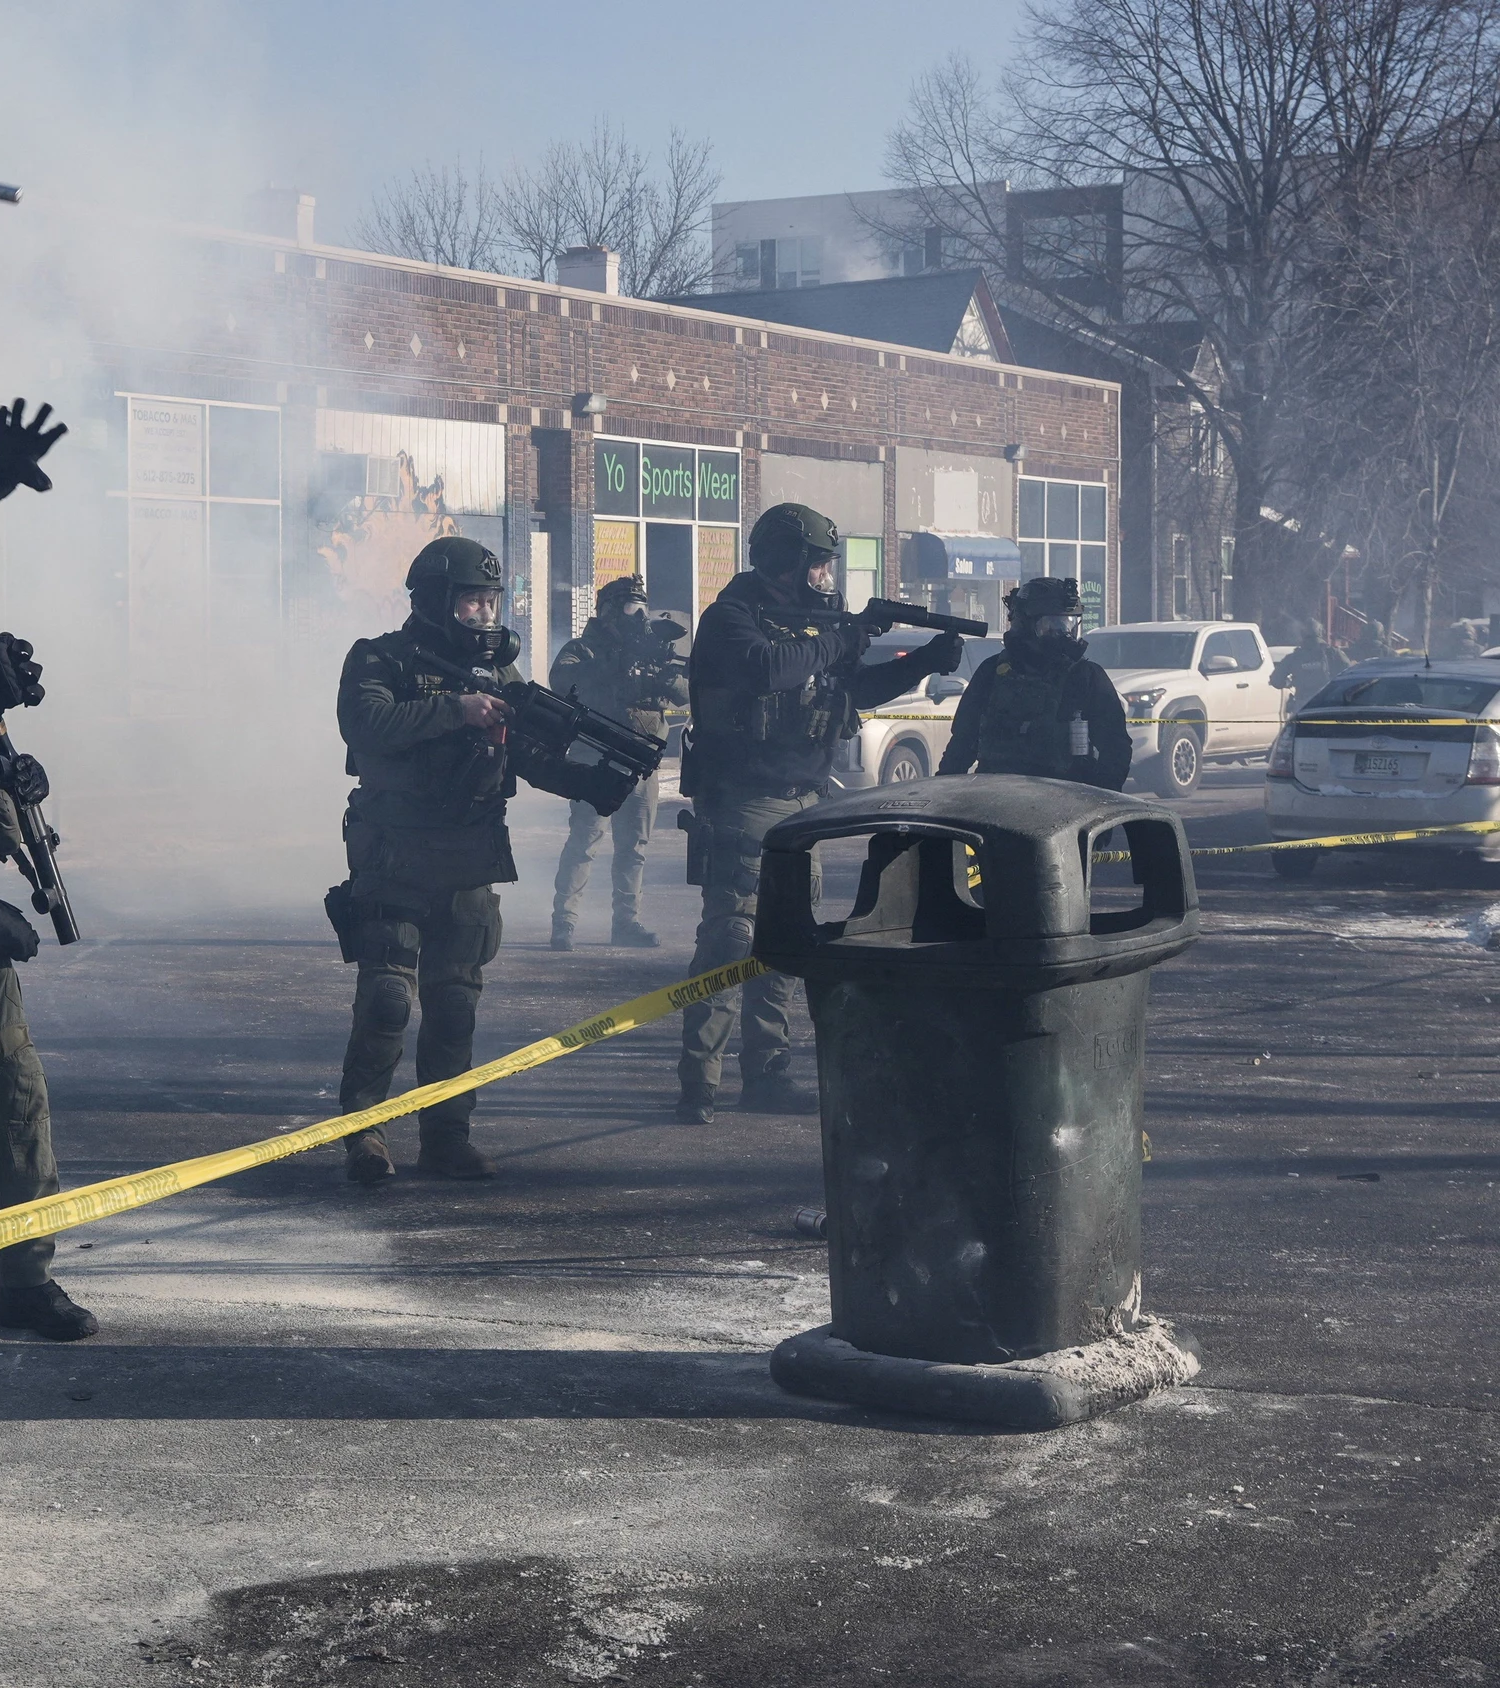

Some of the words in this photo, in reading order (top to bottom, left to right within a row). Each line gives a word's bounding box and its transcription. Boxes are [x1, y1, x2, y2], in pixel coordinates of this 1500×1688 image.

[132, 408, 171, 424] TOBACCO
[172, 413, 179, 424] &
[180, 414, 198, 426] MAS
[143, 470, 196, 485] 612-875-2275
[603, 453, 625, 492] Yo
[641, 456, 693, 505] Sports
[697, 461, 737, 501] Wear
[955, 557, 973, 575] Salon
